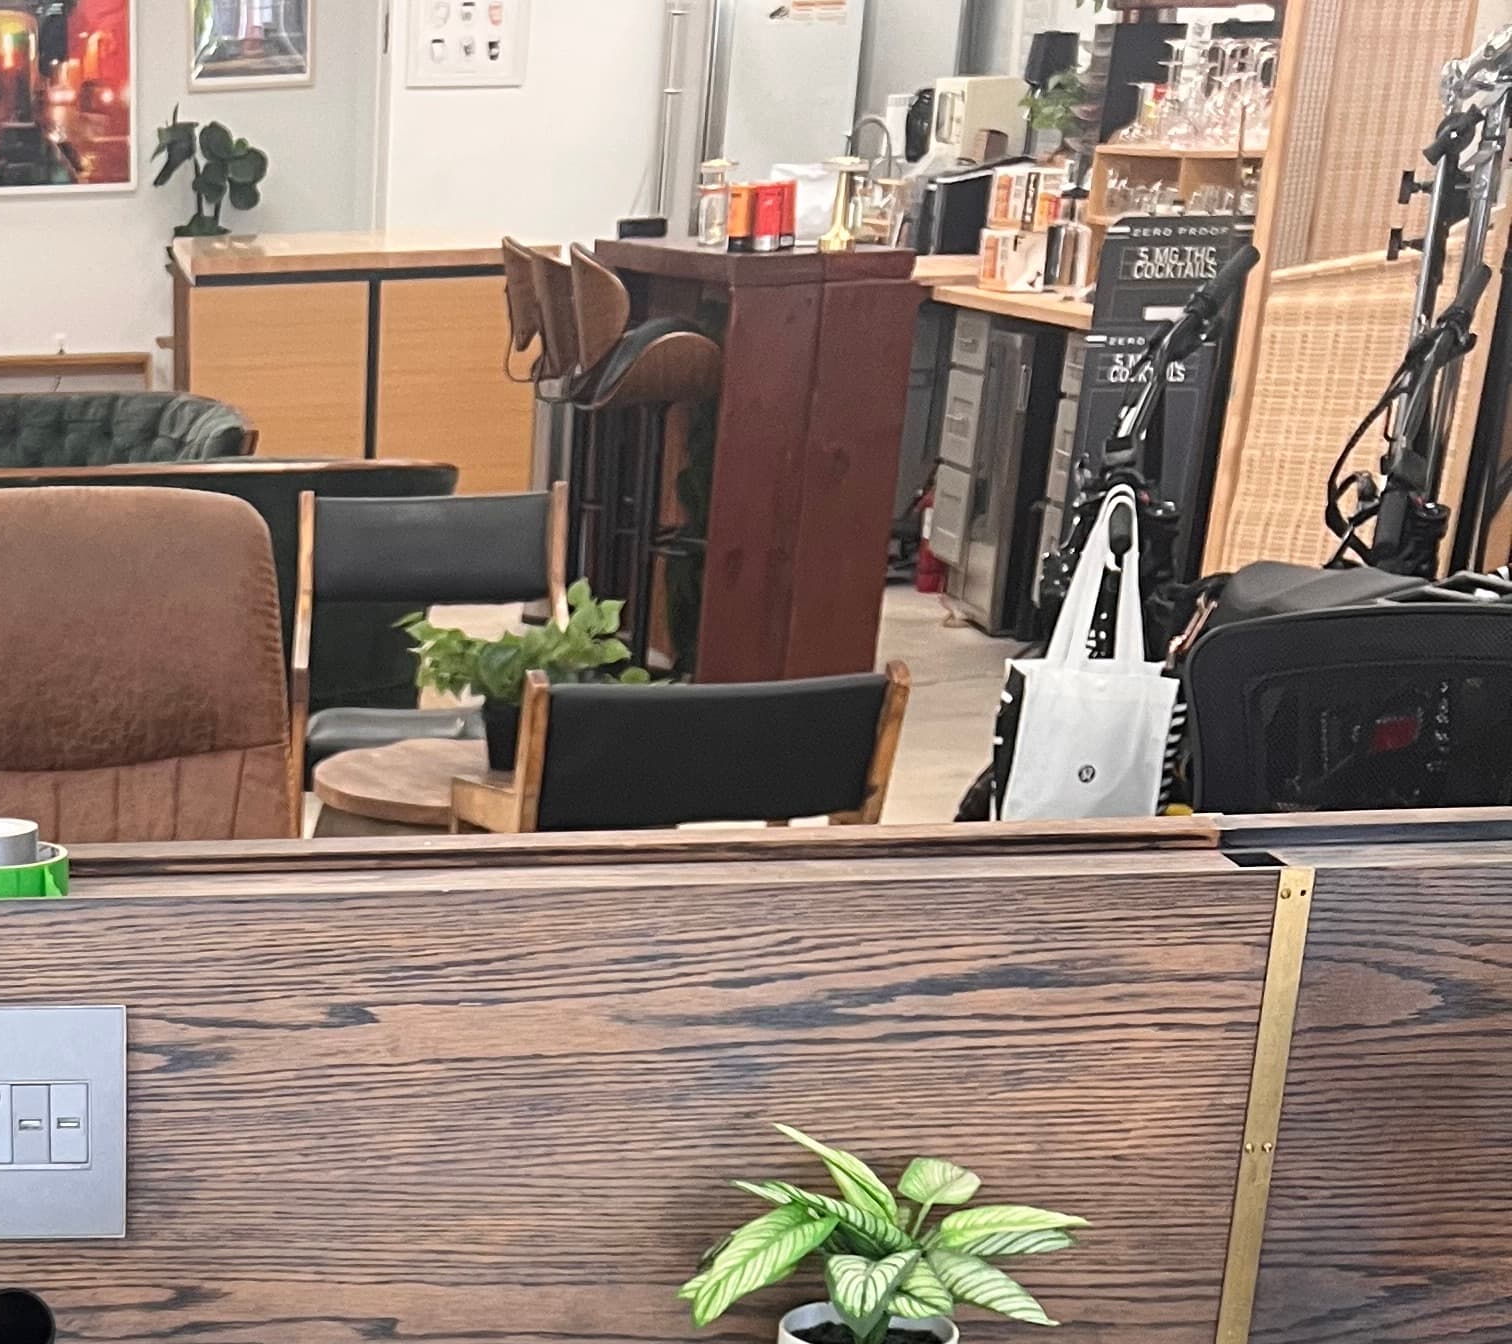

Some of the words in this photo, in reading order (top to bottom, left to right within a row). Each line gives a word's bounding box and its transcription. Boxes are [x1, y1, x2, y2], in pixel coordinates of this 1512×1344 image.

[1132, 228, 1173, 237] ZERO
[1177, 227, 1229, 236] PROOF
[1154, 247, 1179, 263] MG
[1184, 247, 1217, 263] THC
[1134, 262, 1217, 279] COCKTAILS
[1109, 337, 1145, 345] ZERO
